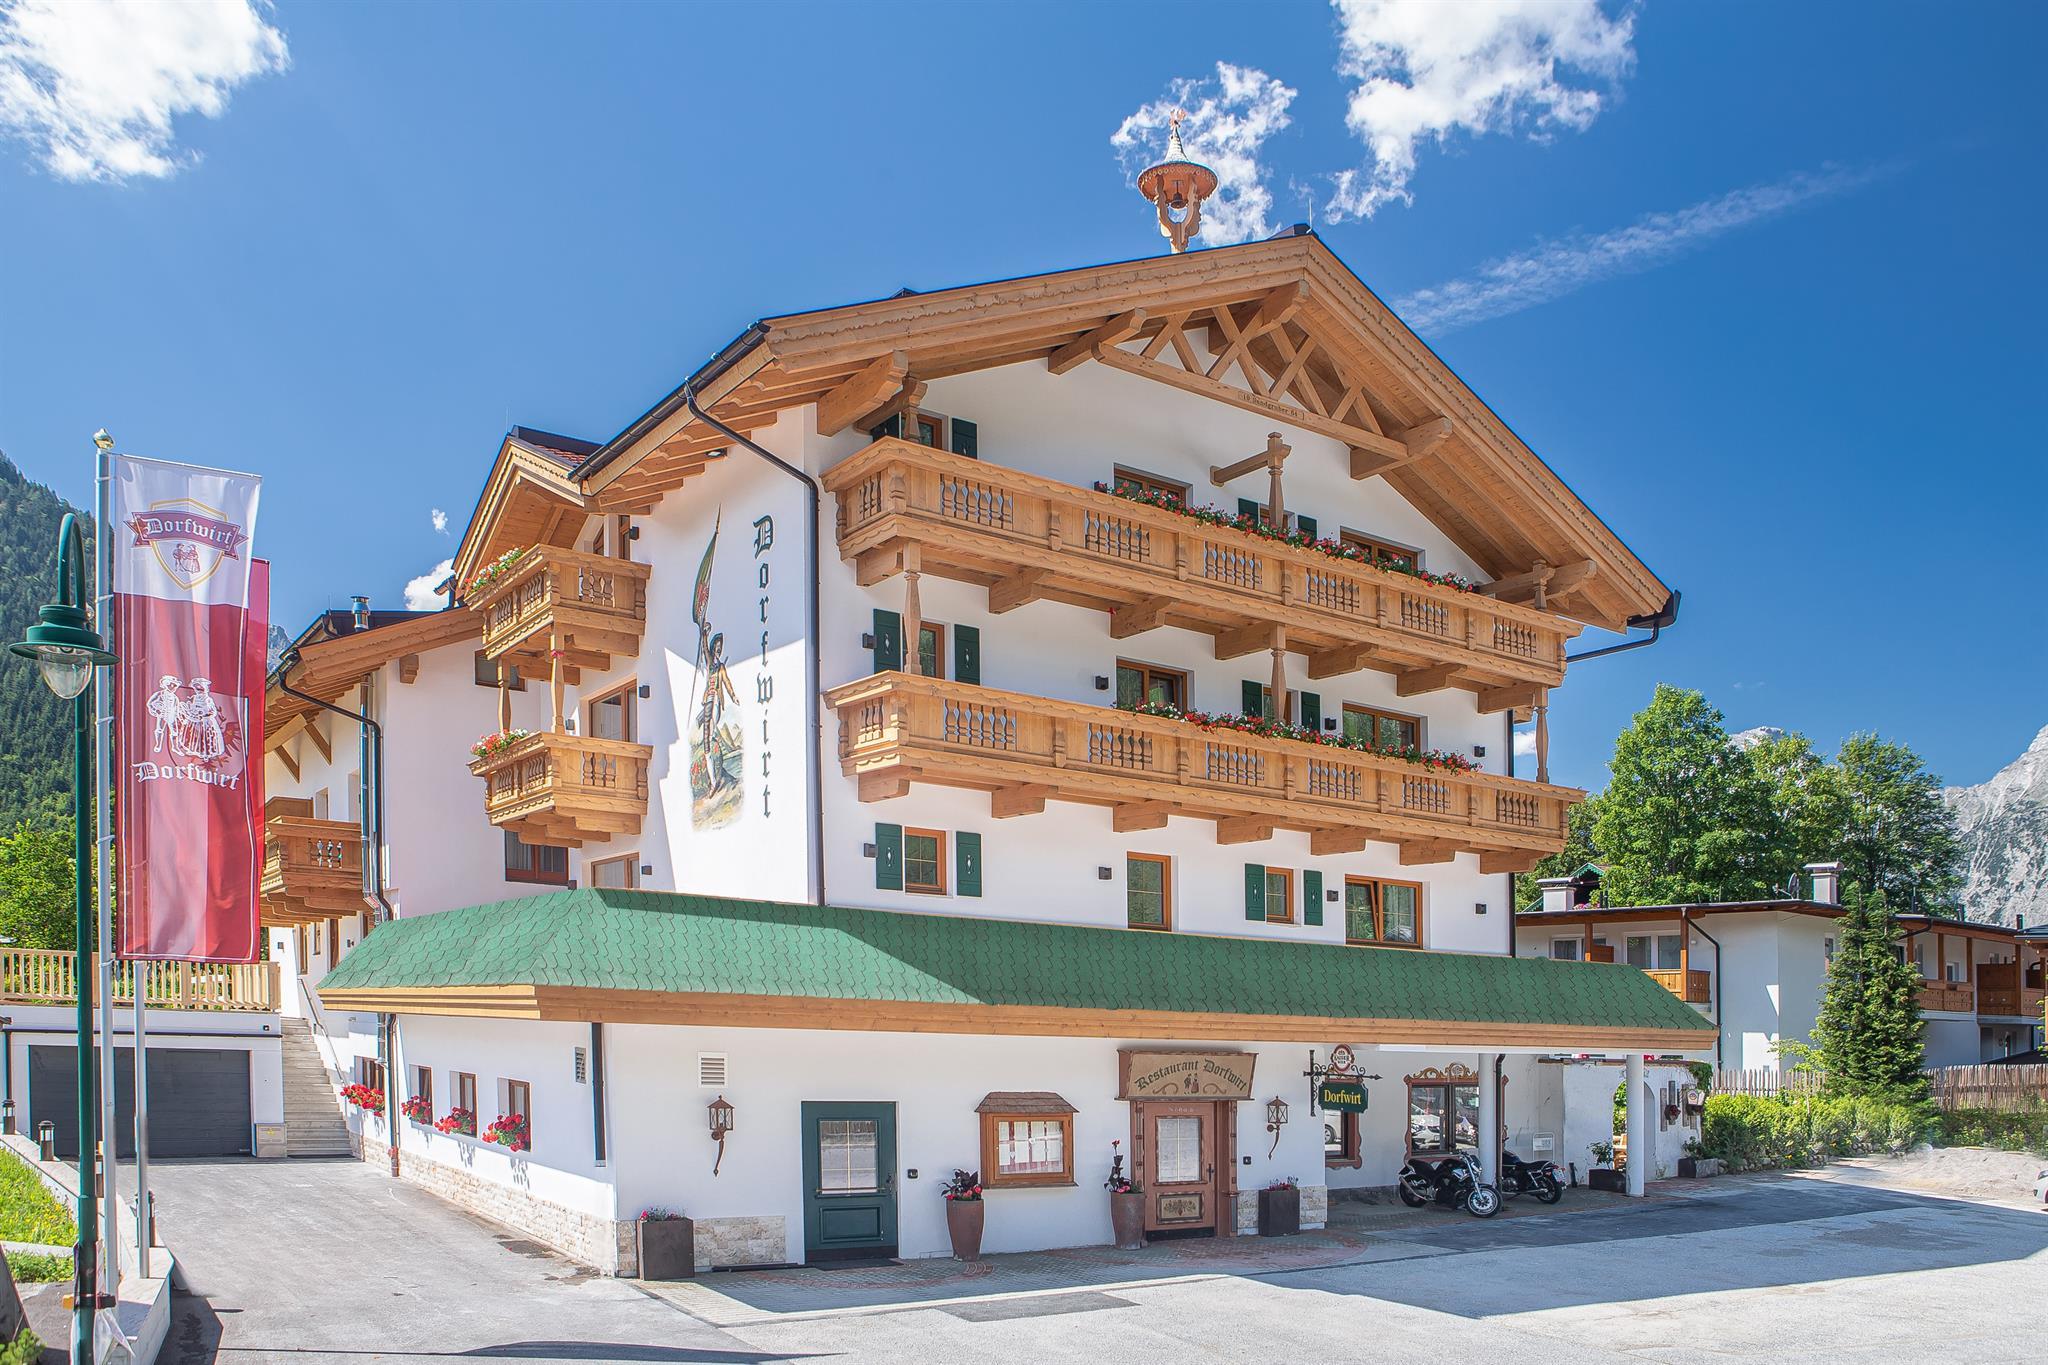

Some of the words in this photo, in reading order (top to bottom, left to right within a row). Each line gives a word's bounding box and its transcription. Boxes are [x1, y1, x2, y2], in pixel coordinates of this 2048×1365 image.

[141, 518, 233, 544] Dorfwirt
[752, 514, 773, 819] Dorfwirt
[130, 761, 240, 790] Dorfwirt
[1134, 1060, 1200, 1090] Restaurant
[1203, 1058, 1249, 1092] Dorfwirt
[1324, 1089, 1362, 1105] Dorfwirt
